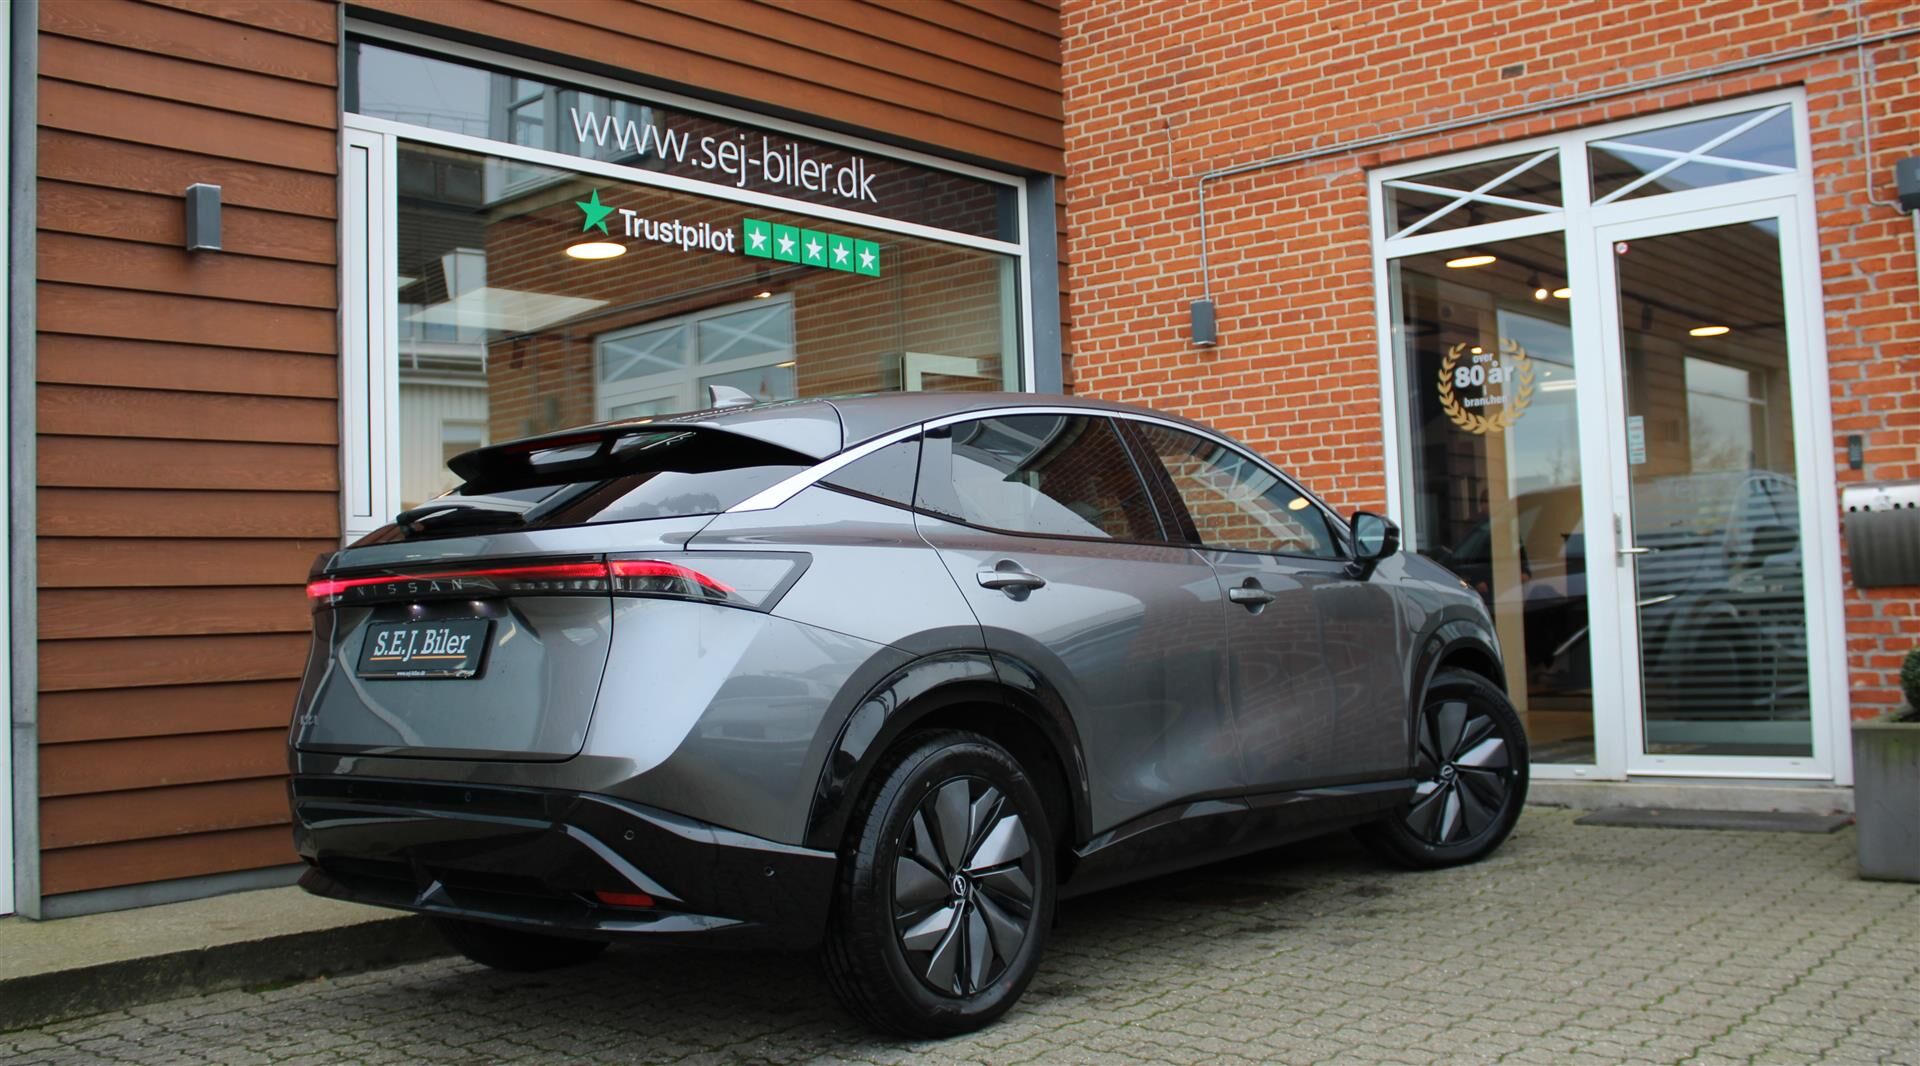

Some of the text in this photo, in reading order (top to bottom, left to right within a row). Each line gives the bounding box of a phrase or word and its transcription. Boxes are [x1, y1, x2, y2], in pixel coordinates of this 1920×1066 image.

[571, 107, 878, 203] www.sej-biler.dk
[618, 208, 735, 254] Trustpilot
[1454, 360, 1515, 388] 80 år
[356, 579, 462, 596] NISSAN
[373, 628, 471, 662] S.E.J. Biler
